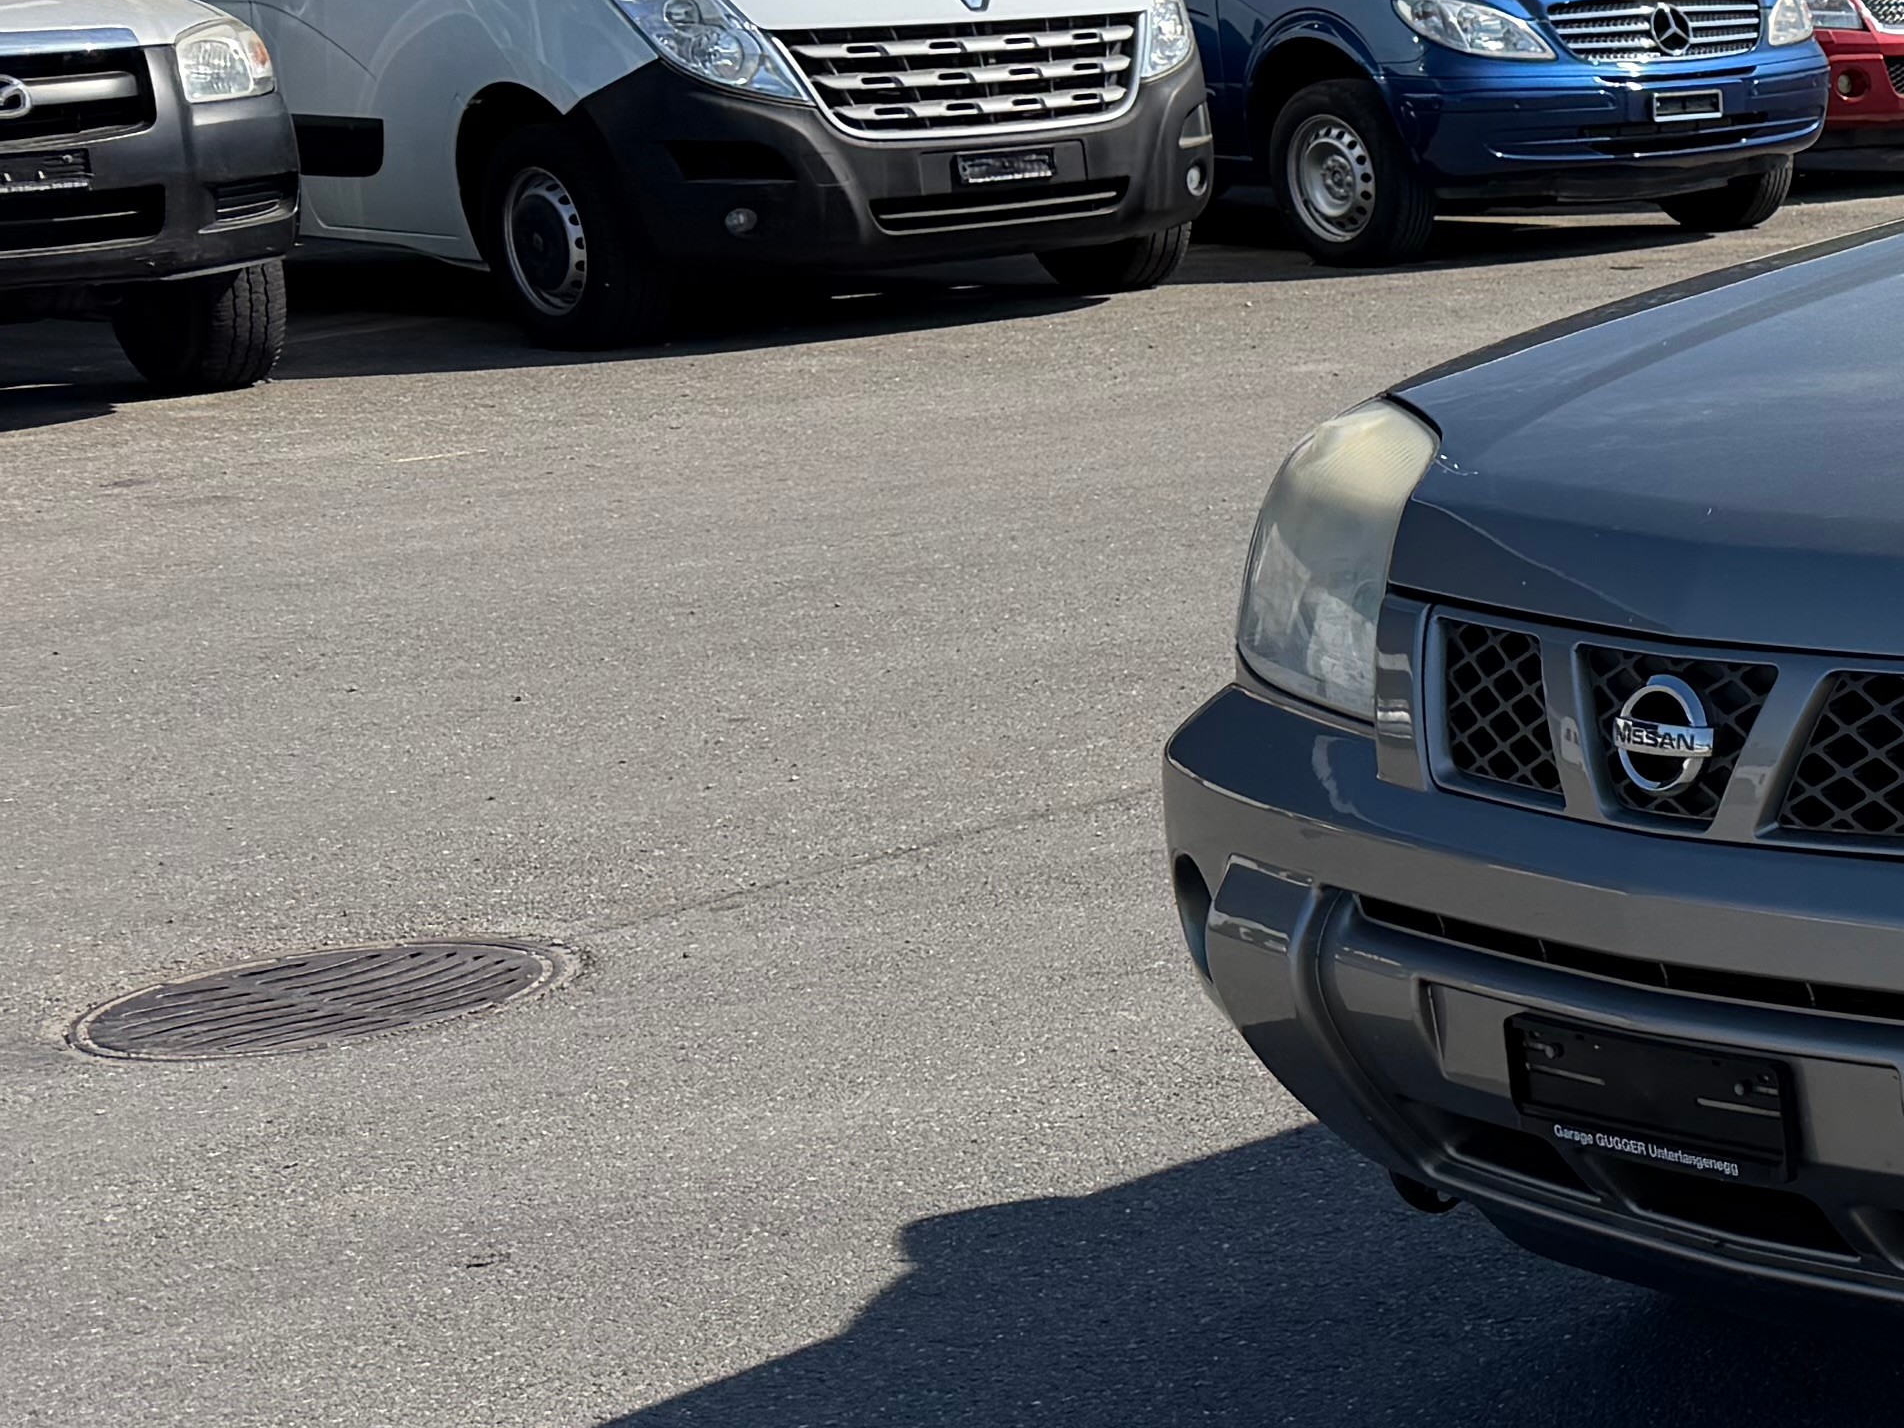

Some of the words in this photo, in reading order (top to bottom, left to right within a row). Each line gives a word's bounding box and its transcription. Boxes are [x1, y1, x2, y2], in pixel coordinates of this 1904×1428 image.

[1615, 722, 1695, 751] NISSAN
[1553, 1123, 1594, 1145] Garage
[1595, 1133, 1646, 1156] GUGGER
